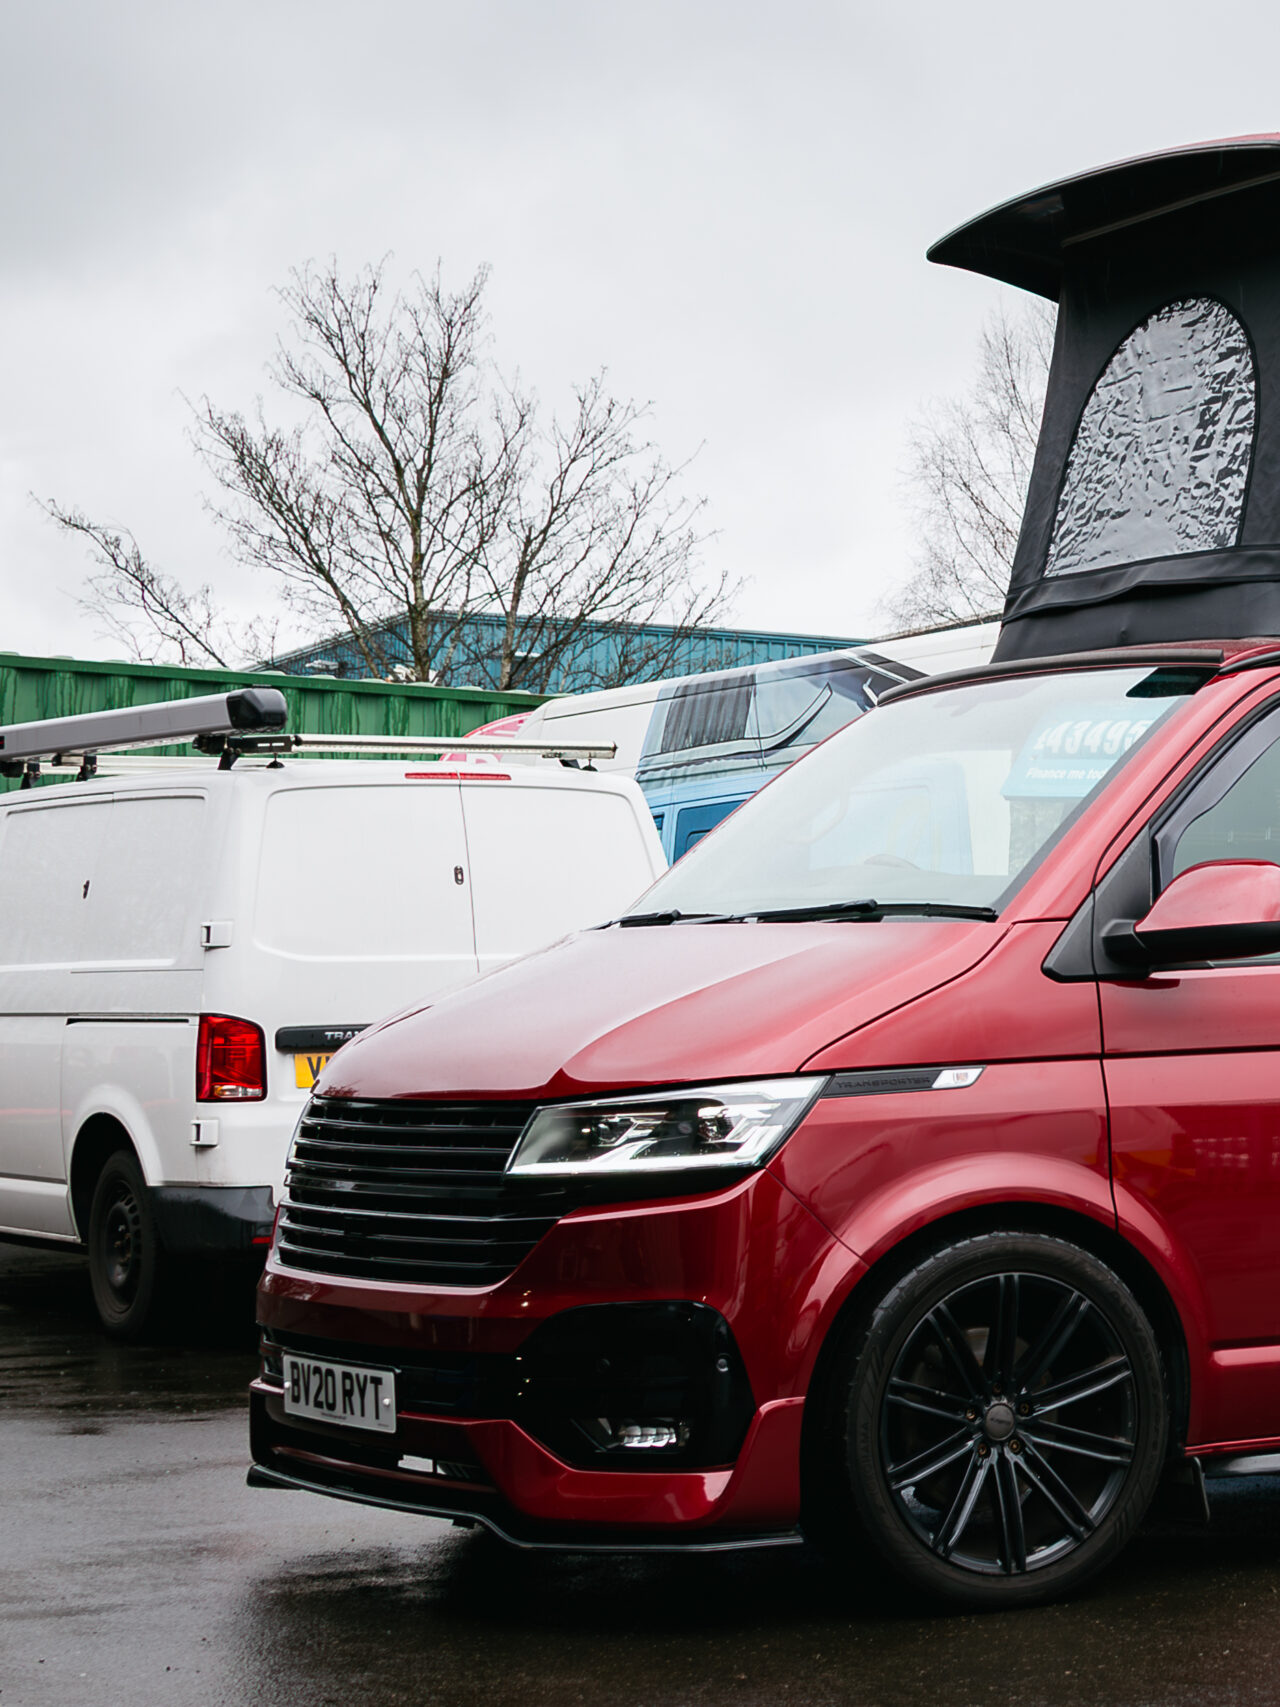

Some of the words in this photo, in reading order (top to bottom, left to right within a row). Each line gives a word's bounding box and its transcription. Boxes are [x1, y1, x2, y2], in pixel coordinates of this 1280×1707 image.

[1026, 768, 1066, 779] Finance
[1067, 769, 1086, 779] me
[306, 1056, 330, 1080] V
[837, 1076, 931, 1089] TRANSPORTER
[290, 1361, 336, 1412] BV20
[341, 1370, 383, 1420] RYT
